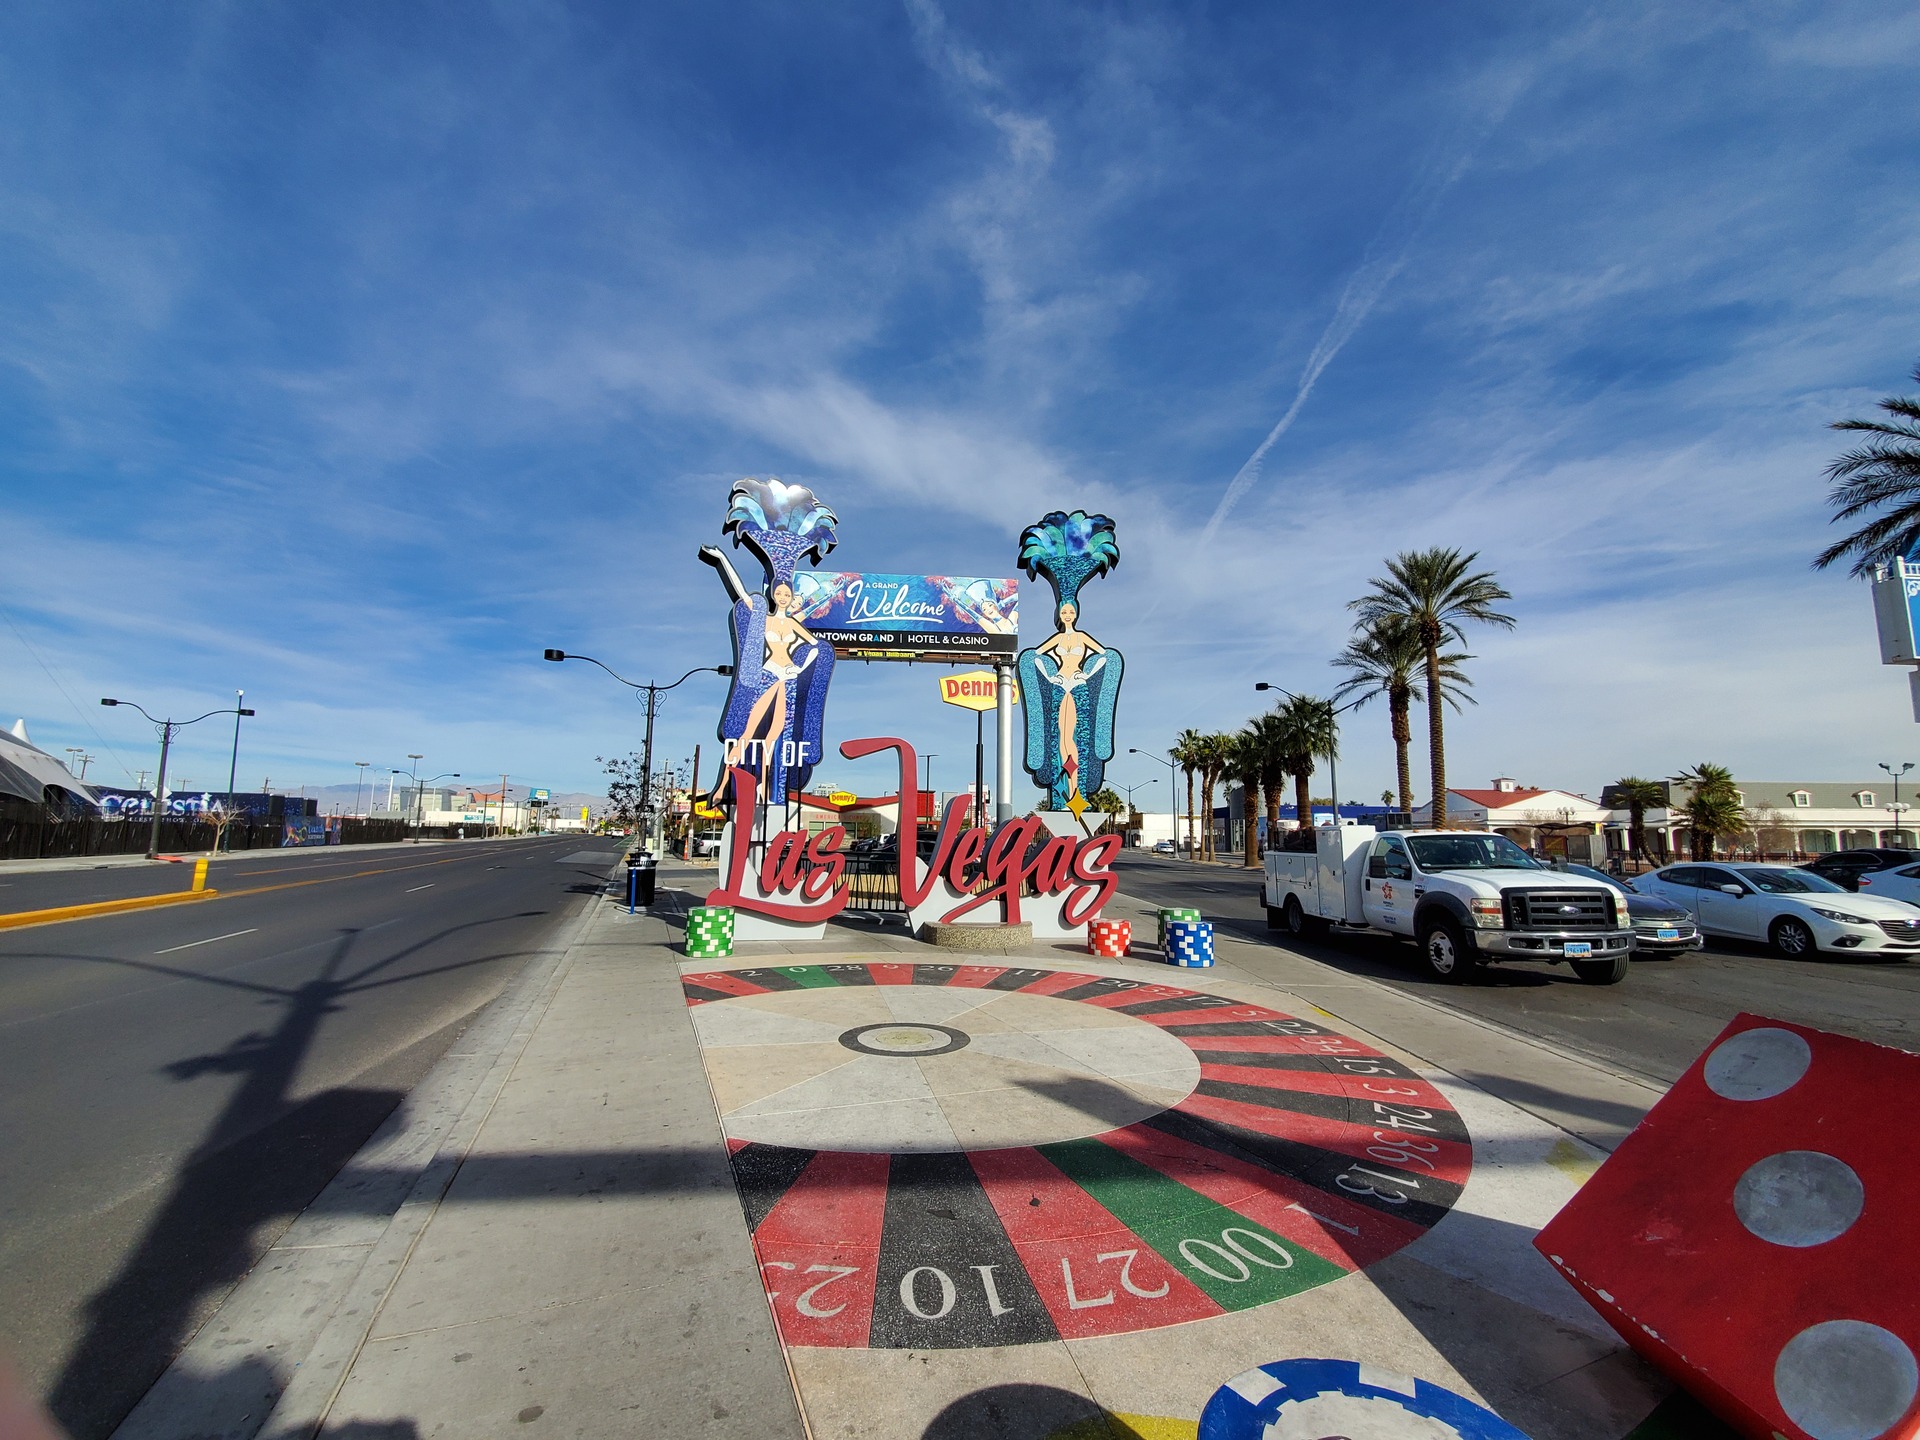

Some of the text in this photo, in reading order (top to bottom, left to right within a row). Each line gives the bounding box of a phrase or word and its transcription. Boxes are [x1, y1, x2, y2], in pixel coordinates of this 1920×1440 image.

[846, 580, 946, 620] Welcome
[812, 631, 990, 646] WNTOWN GRAND HOTEL & CASINO
[723, 738, 811, 768] CITY OF
[832, 794, 855, 803] Denny's
[839, 736, 1123, 926] Vegas
[705, 766, 849, 922] Las
[685, 973, 723, 983] 14
[964, 966, 1001, 974] 30
[1013, 969, 1042, 977] 11
[1097, 979, 1139, 989] 20
[1139, 986, 1185, 997] 32
[1183, 996, 1232, 1005] 17
[1299, 1037, 1361, 1053] 34
[1333, 1056, 1397, 1076] 15
[1362, 1082, 1419, 1097] 3
[1372, 1101, 1440, 1134] 24
[1365, 1130, 1440, 1171] 36
[1334, 1162, 1422, 1206] 13
[1285, 1203, 1360, 1237] 1
[1178, 1227, 1294, 1284] 00
[1060, 1247, 1170, 1311] 27
[899, 1263, 1016, 1321] 10
